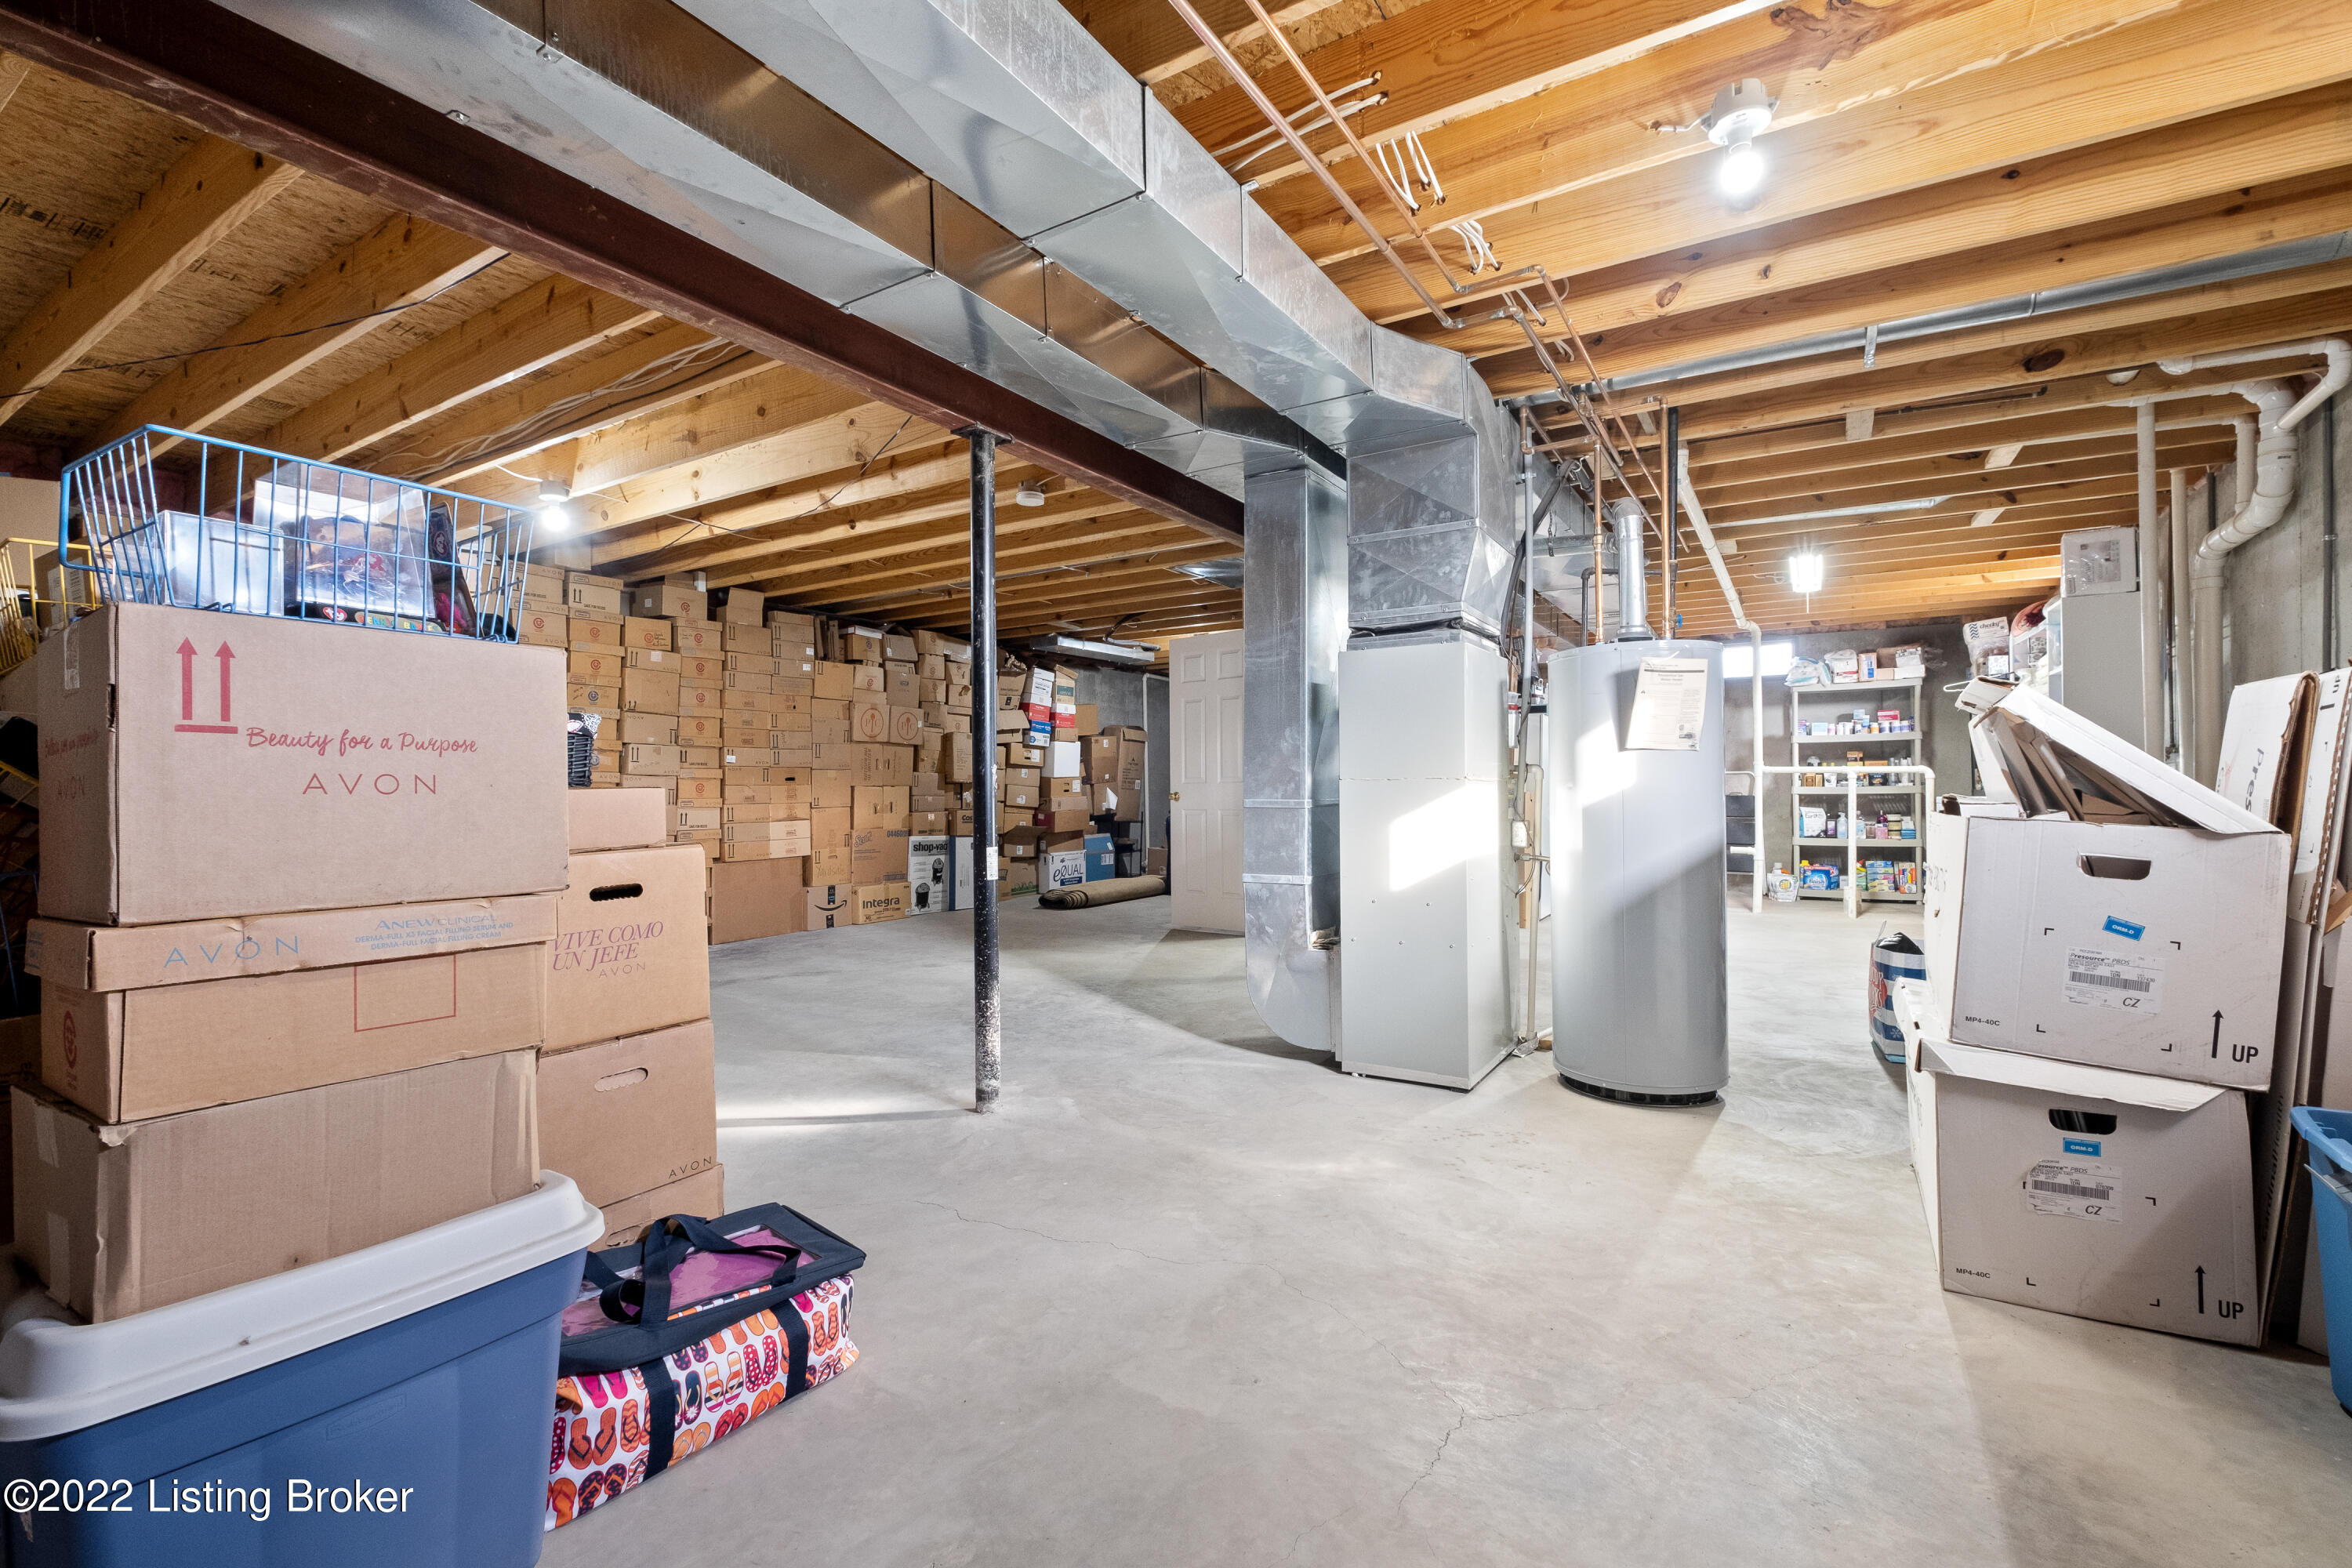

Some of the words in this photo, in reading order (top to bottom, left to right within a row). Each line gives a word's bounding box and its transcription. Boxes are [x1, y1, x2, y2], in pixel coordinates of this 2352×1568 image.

[246, 727, 334, 757] Beauty
[339, 728, 374, 757] for
[380, 737, 392, 750] a
[398, 731, 477, 757] Purpose
[303, 772, 437, 795] AVON
[862, 896, 900, 909] Integra
[473, 924, 497, 932] SERUM
[499, 921, 514, 930] AND
[475, 931, 502, 939] CREAM
[554, 928, 603, 953] VIVE
[608, 920, 663, 944] COMO
[163, 935, 299, 968] AVON
[553, 949, 586, 971] UN
[586, 942, 640, 972] JEFE
[598, 961, 647, 979] AVON
[2122, 996, 2141, 1008] CZ
[1965, 1015, 2001, 1027] MP4-40C
[2231, 1044, 2259, 1064] UP
[668, 1156, 712, 1180] AVON
[2085, 1205, 2103, 1216] CZ
[1956, 1267, 1991, 1279] MP4-40C
[2217, 1299, 2245, 1319] UP
